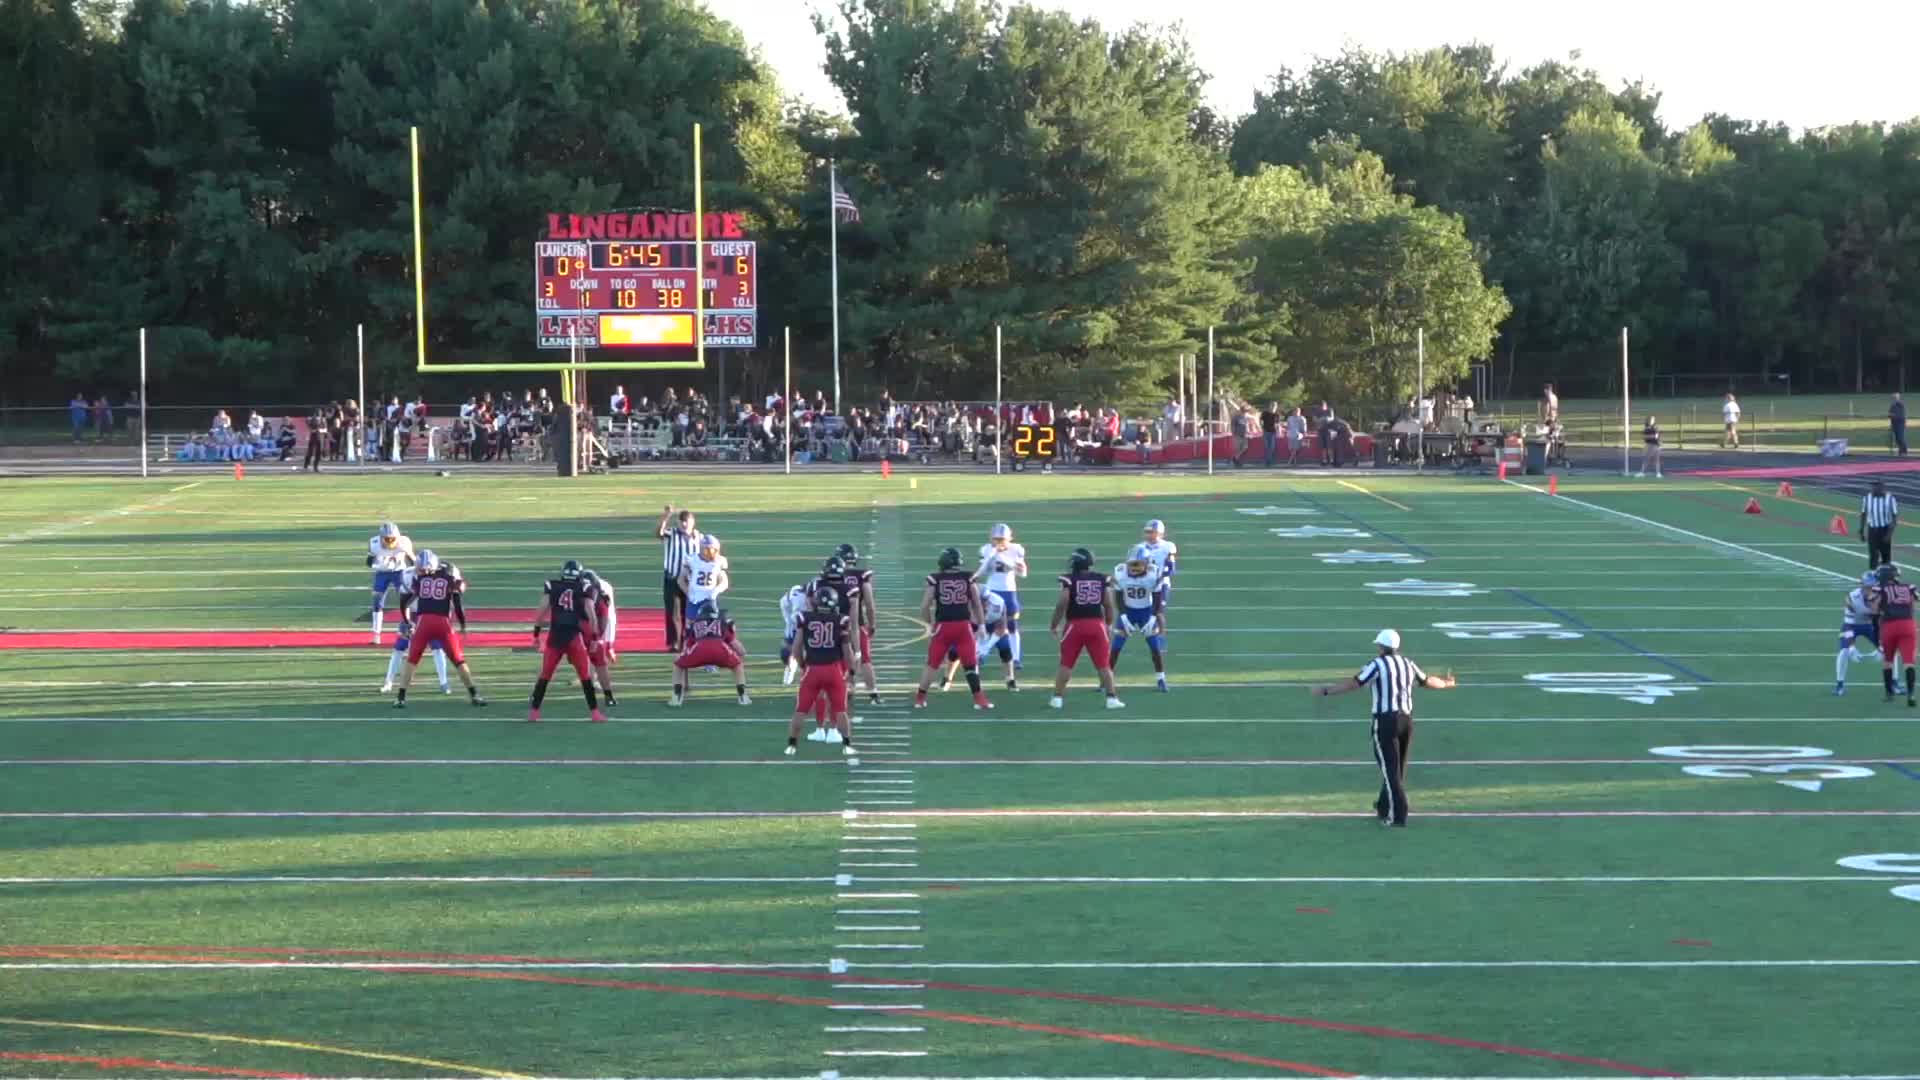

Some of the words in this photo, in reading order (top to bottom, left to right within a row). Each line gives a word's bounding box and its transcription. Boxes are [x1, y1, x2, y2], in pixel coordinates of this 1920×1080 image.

[548, 213, 742, 239] LINGANORE
[540, 244, 587, 257] LANCERS
[608, 243, 661, 267] 6:45
[711, 243, 752, 256] GUEST
[557, 257, 569, 276] 0
[736, 256, 748, 275] 6
[545, 282, 554, 297] 3
[570, 279, 598, 289] DOWN
[610, 279, 621, 289] TO
[624, 279, 637, 289] GO
[652, 279, 671, 289] BALL
[674, 279, 686, 289] ON
[702, 279, 718, 289] TR
[739, 281, 748, 296] 3
[617, 289, 637, 309] 10
[658, 289, 682, 308] 38
[540, 316, 596, 336] LHS
[1015, 426, 1055, 455] 22
[420, 578, 448, 600] 88
[938, 579, 968, 605] 52
[1076, 579, 1104, 605] 55
[558, 588, 575, 611] 4
[807, 620, 835, 648] 31
